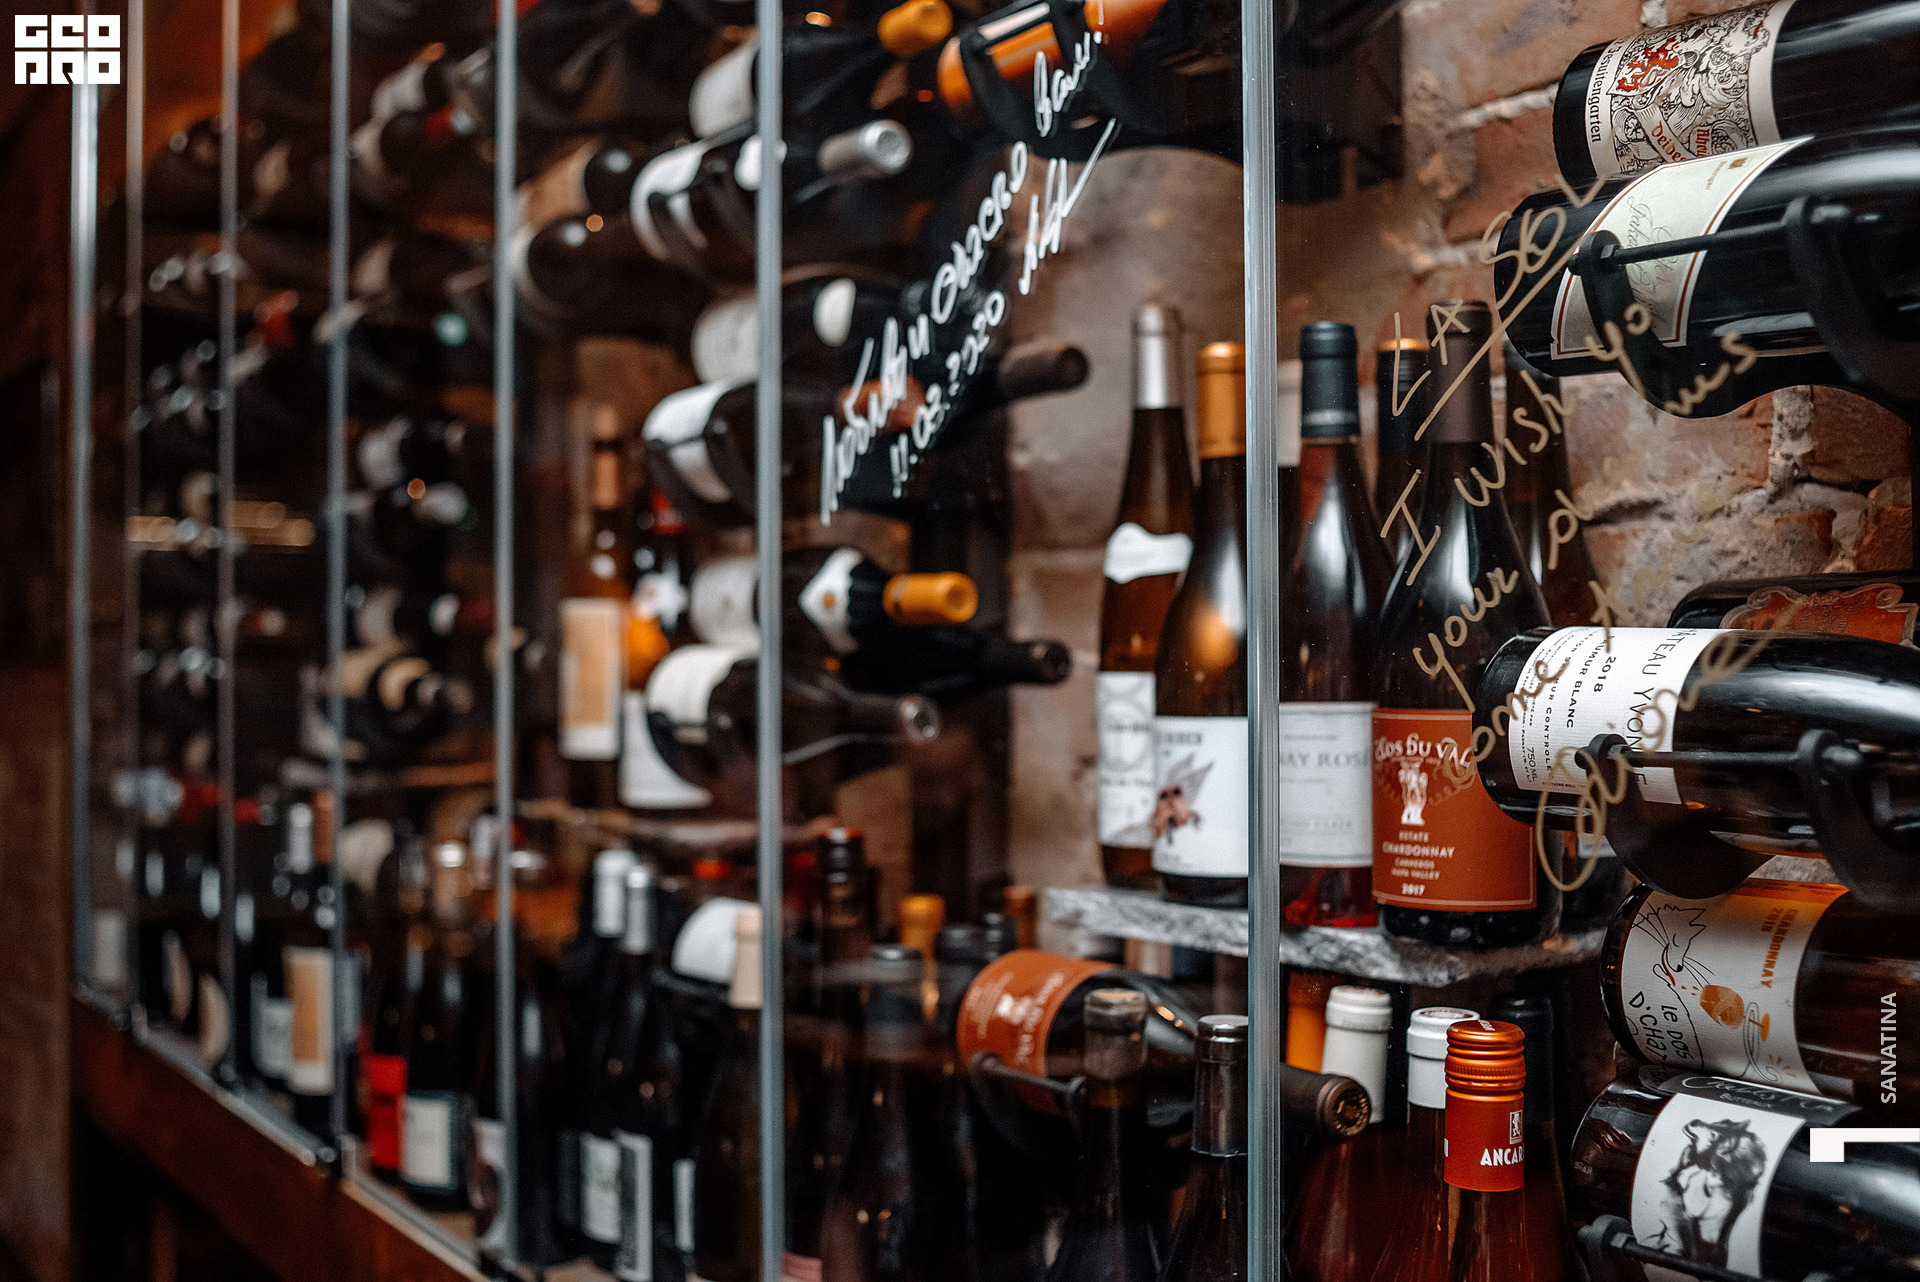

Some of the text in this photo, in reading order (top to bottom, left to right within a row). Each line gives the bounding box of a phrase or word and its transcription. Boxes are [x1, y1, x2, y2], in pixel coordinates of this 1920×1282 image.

[1392, 298, 1471, 417] LA
[1380, 469, 1441, 586] I
[1412, 567, 1519, 713] your
[1594, 656, 1617, 693] 2018
[1566, 680, 1583, 728] BLANC
[1626, 687, 1654, 785] YVONE
[1382, 840, 1455, 859] CHARDONNAY
[1401, 882, 1425, 897] 2017
[1760, 908, 1798, 989] CHARDONNAY
[1666, 1030, 1695, 1059] DOS
[1480, 1146, 1525, 1167] ANCAR
